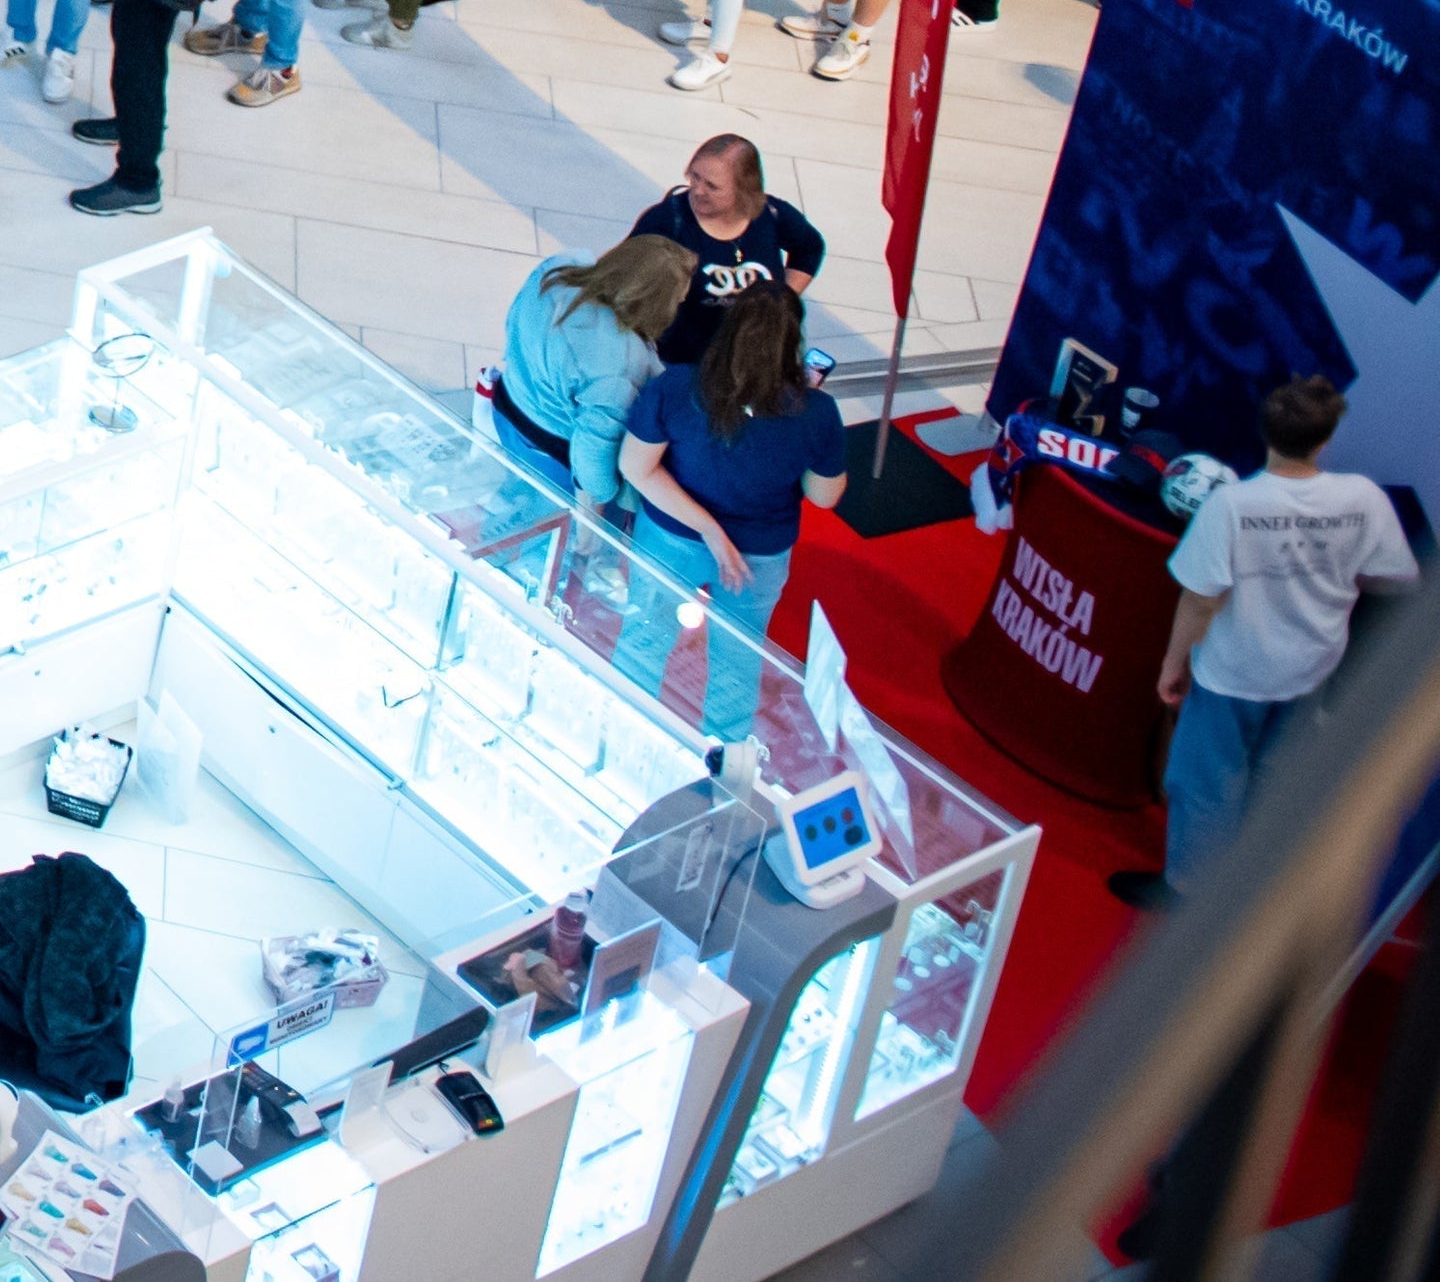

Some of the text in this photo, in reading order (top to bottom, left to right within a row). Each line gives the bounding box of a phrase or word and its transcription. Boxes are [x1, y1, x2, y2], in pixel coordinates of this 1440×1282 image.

[1241, 512, 1367, 532] INNER GROWTH
[992, 578, 1104, 694] KRAKÓW
[1012, 536, 1096, 636] WISŁA
